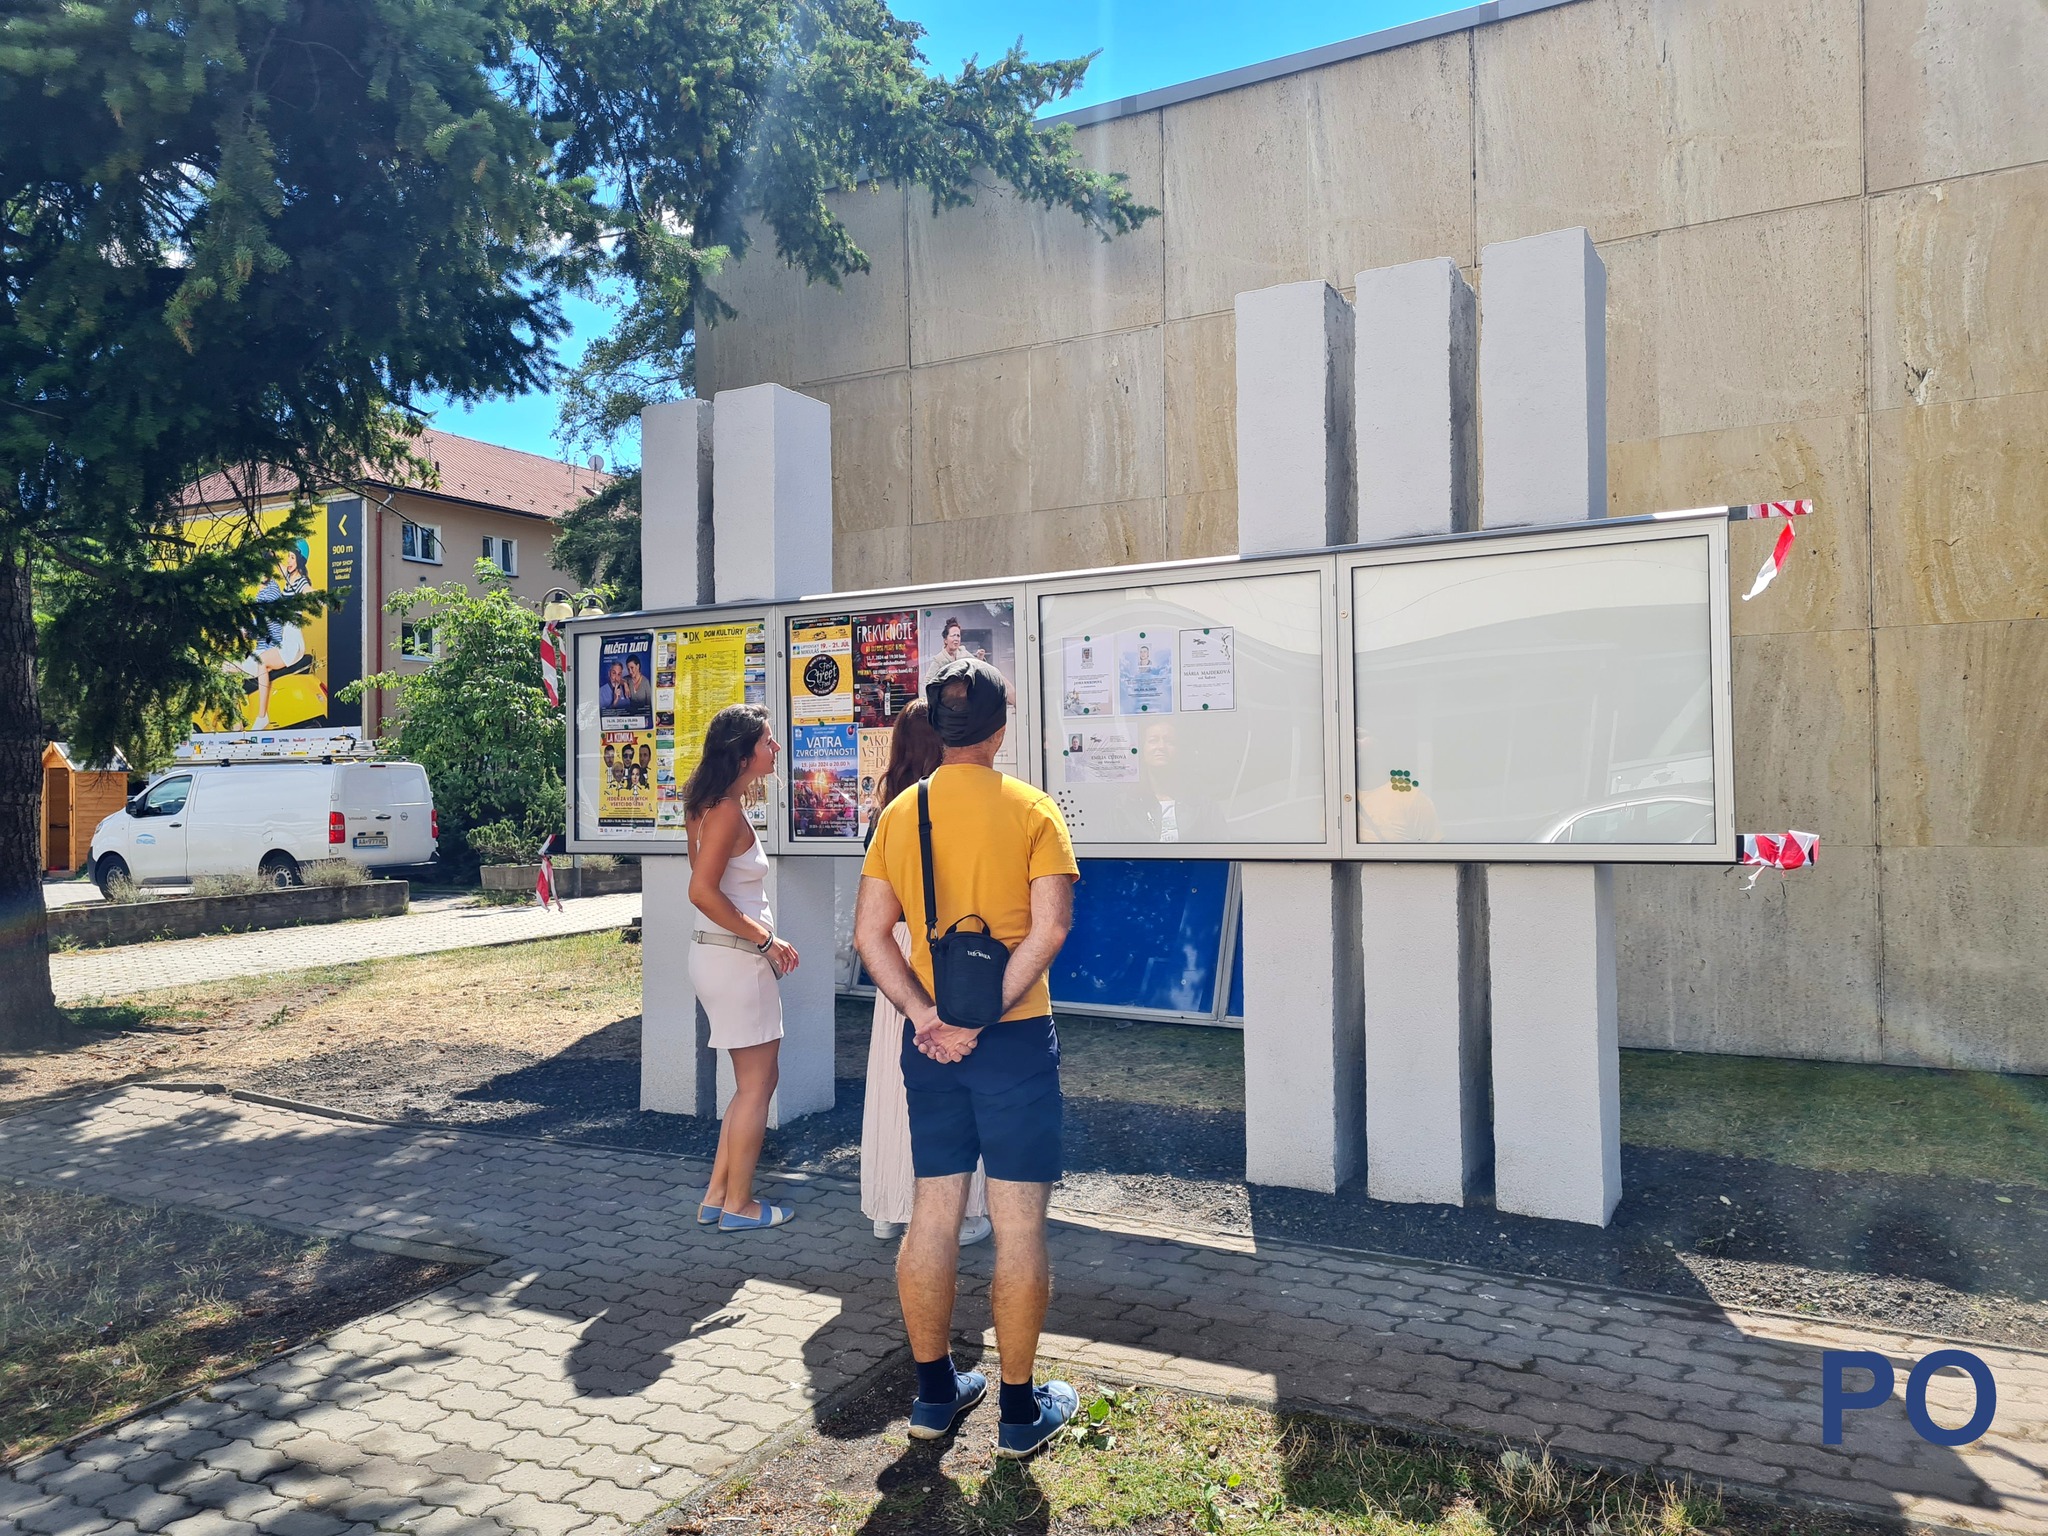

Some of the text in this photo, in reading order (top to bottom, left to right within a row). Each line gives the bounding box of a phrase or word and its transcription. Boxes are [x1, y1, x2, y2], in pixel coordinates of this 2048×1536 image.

[332, 544, 354, 554] 900 m
[689, 631, 700, 642] DK
[704, 630, 716, 638] DOM
[716, 626, 744, 637] KULTÚRY
[856, 622, 913, 643] FREKVENCIE
[603, 641, 649, 655] MLČETI ZLATO
[806, 664, 837, 688] Street
[606, 732, 614, 743] LA
[806, 736, 842, 749] VATRA
[869, 735, 889, 747] AKO
[795, 747, 856, 757] ZVRCHOVANOSTI
